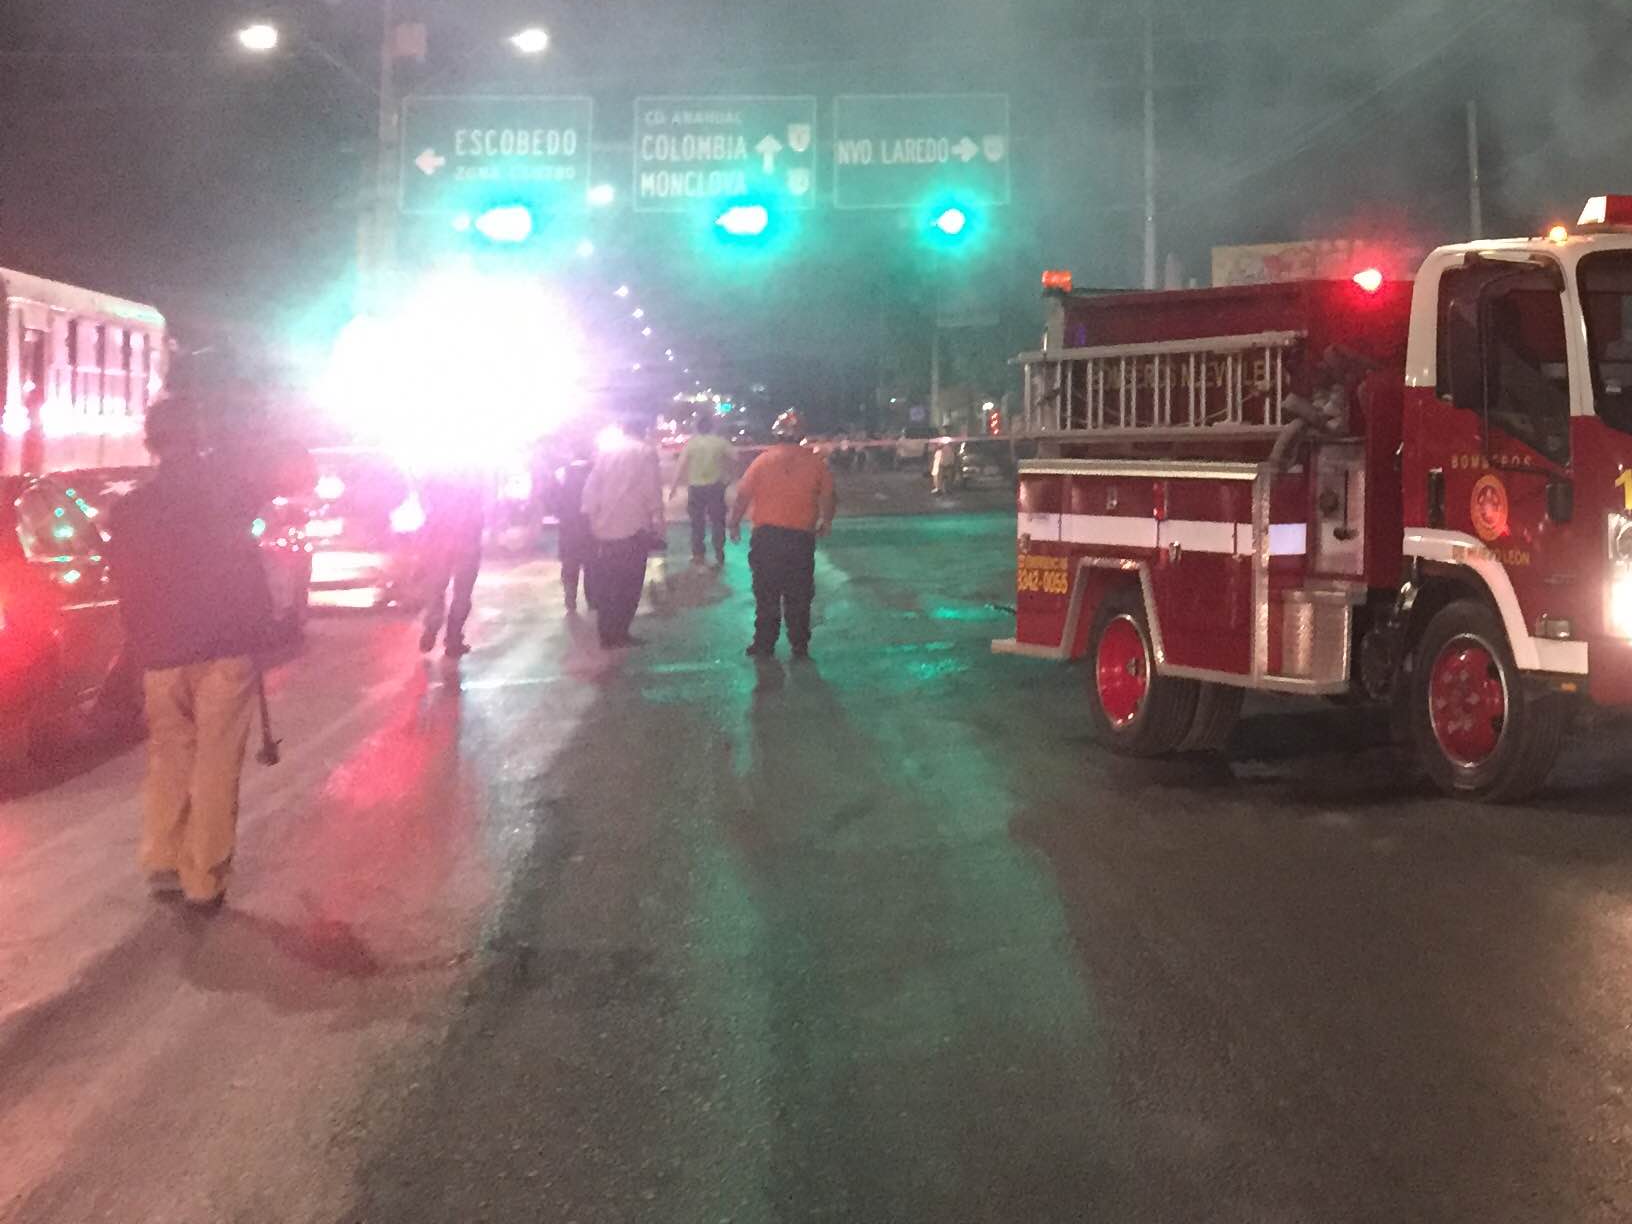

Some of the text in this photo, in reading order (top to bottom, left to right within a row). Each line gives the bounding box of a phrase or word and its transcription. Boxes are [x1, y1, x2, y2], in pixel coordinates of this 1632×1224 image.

[455, 129, 577, 157] ESCOBEDO
[641, 135, 748, 161] COLOMBIA
[881, 138, 949, 163] LAREDO
[640, 170, 748, 197] MONCLOVA
